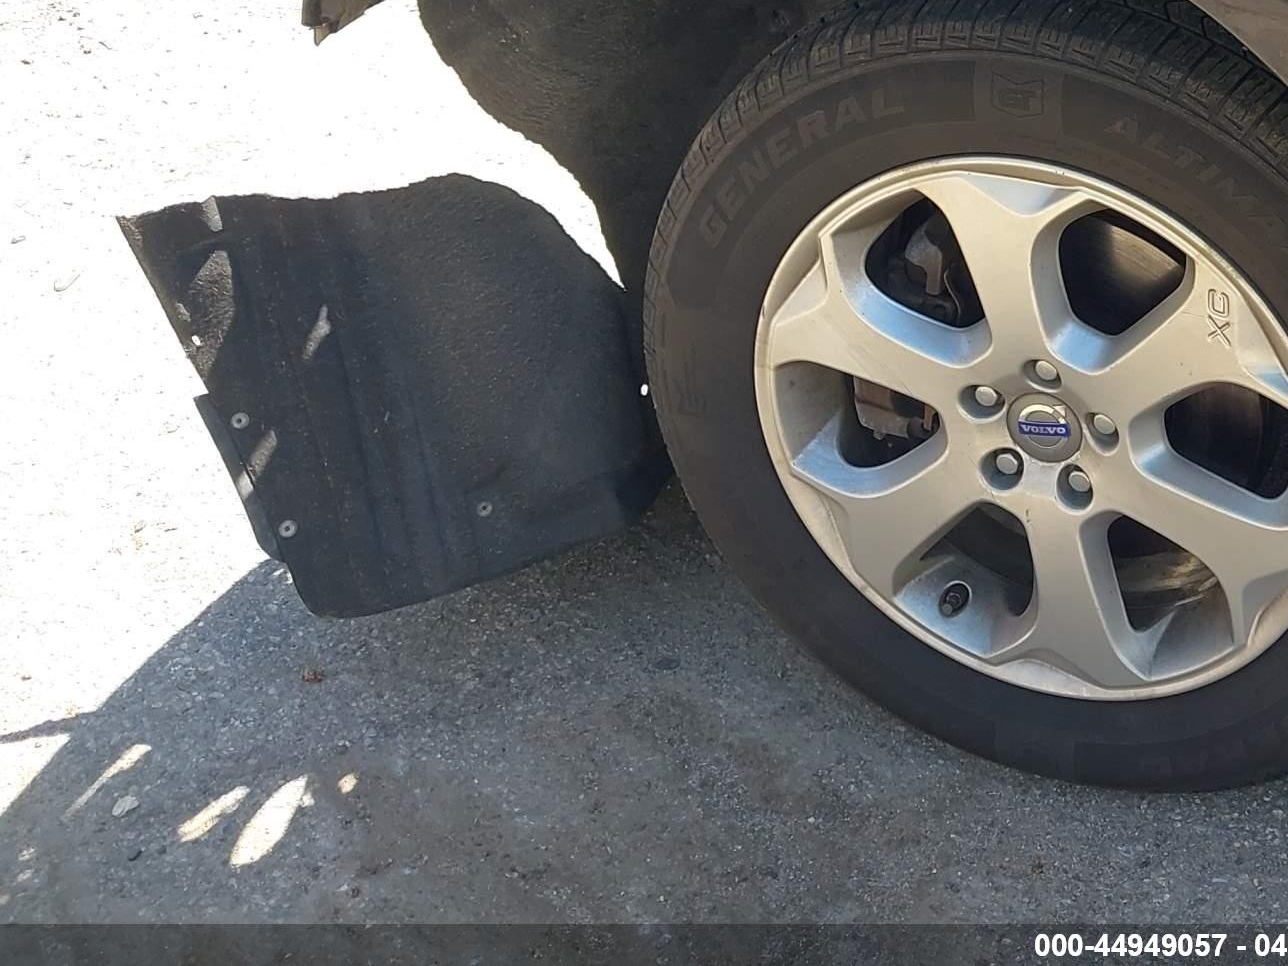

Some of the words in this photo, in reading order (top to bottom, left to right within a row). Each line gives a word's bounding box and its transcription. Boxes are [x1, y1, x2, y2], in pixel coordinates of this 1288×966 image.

[701, 87, 906, 249] GENERAL
[1207, 288, 1231, 348] XC
[1020, 424, 1066, 434] VOLVO
